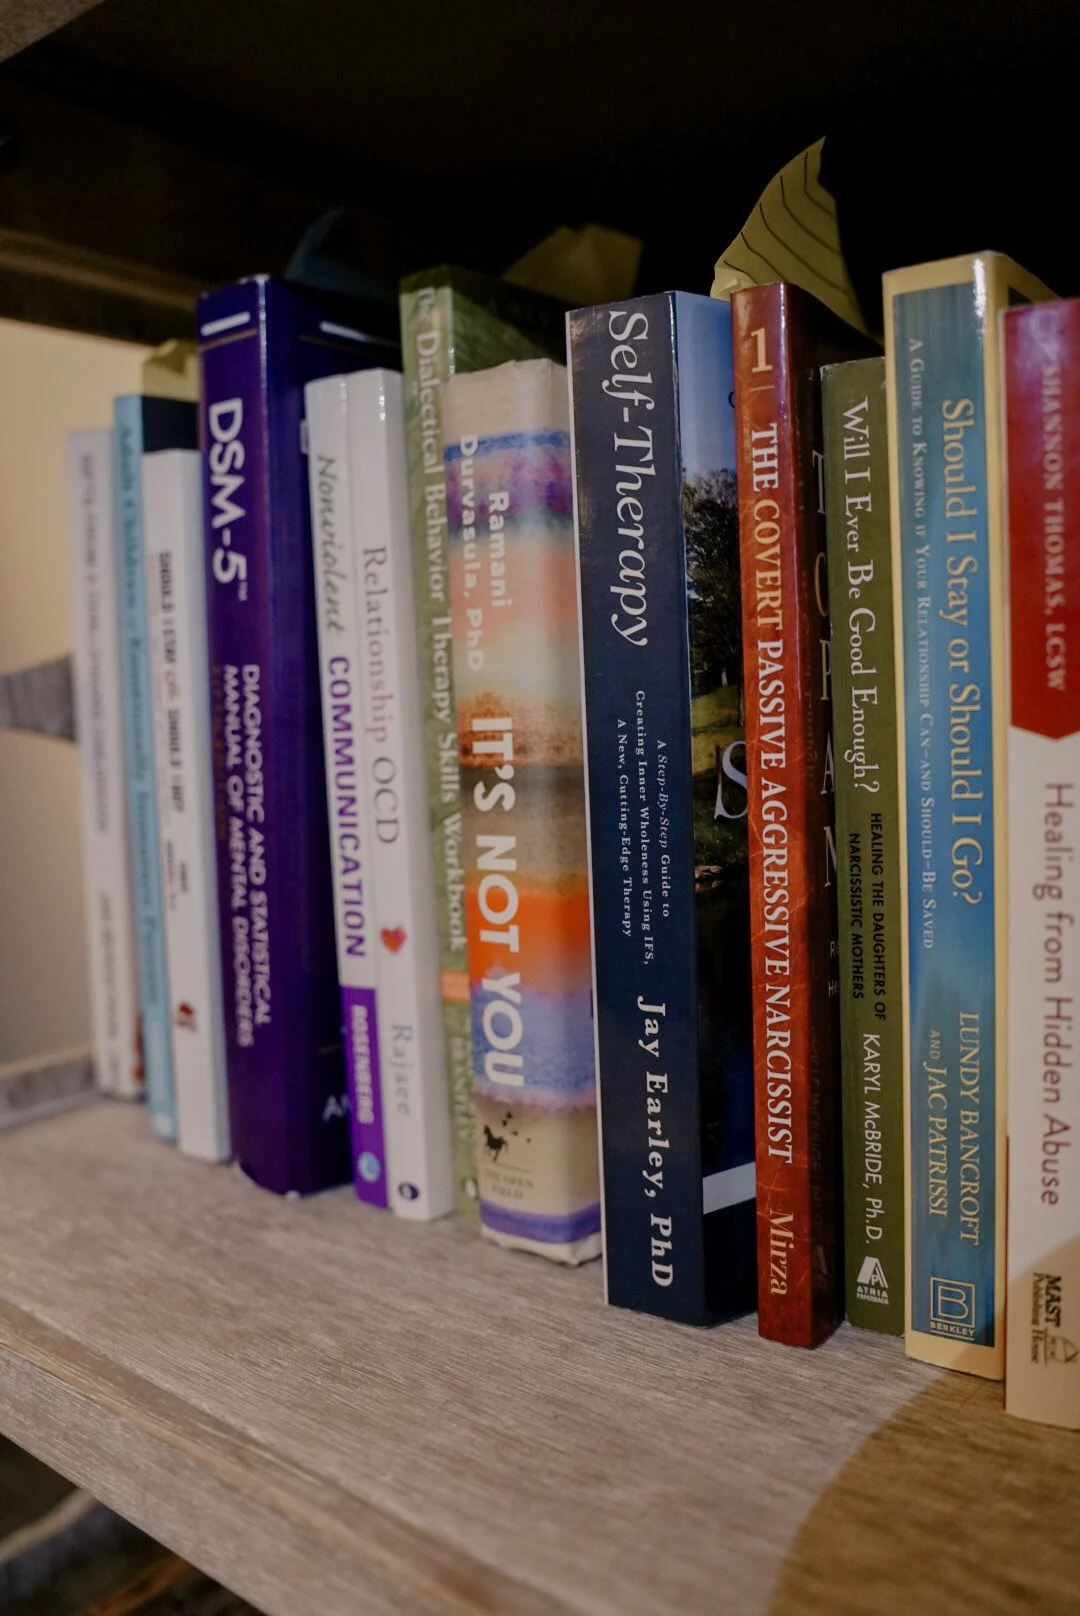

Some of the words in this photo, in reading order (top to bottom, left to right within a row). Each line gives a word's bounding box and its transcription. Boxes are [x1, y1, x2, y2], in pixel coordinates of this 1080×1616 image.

[750, 327, 773, 373] 1
[909, 338, 924, 353] A
[416, 330, 443, 474] Dialectical
[841, 397, 871, 461] Will
[1042, 363, 1064, 491] SHANNON
[209, 398, 247, 584] DSM-5
[601, 310, 655, 646] Self-Therapy
[750, 422, 780, 492] THE
[844, 468, 871, 485] I
[941, 398, 978, 519] Should
[316, 454, 349, 637] Nonviolent
[424, 482, 449, 603] Behavior
[460, 435, 482, 598] Durvasula,
[488, 491, 512, 608] Ramani
[844, 494, 872, 553] Ever
[946, 530, 977, 543] I
[1043, 498, 1065, 615] THOMAS,
[753, 499, 784, 630] COVERT
[847, 559, 874, 599] Be
[938, 555, 979, 627] Stay
[362, 545, 394, 745] Relationship
[431, 609, 454, 724] Therapy
[466, 608, 484, 672] PhD
[849, 607, 876, 676] Good
[948, 638, 971, 674] or
[1045, 622, 1066, 692] LCSW
[223, 664, 242, 770] MANUAL
[242, 664, 265, 822] DIAGNOSTIC
[617, 718, 627, 729] A
[635, 690, 647, 756] Creating
[657, 739, 667, 750] A
[757, 639, 787, 769] PASSIVE
[844, 686, 880, 793] Enough?
[949, 683, 984, 800] Should
[437, 731, 461, 803] Skills
[471, 717, 516, 812] IT'S
[616, 734, 628, 769] New,
[638, 761, 649, 802] Inner
[226, 775, 244, 812] OF
[329, 656, 366, 957] COMMUNICATION
[372, 757, 400, 845] OCD
[618, 774, 632, 872] Cutting-Edge
[657, 755, 670, 848] Step-By-Step
[952, 812, 982, 825] I
[229, 817, 248, 910] MENTAL
[248, 828, 267, 885] AND
[442, 812, 468, 952] Workbook
[639, 806, 651, 884] Wholeness
[660, 854, 671, 898] Guide
[760, 777, 790, 976] AGGRESSIVE
[849, 833, 863, 928] NARCISSISTIC
[870, 813, 884, 876] HEALING
[951, 836, 984, 906] Go?
[1032, 782, 1073, 901] Healing
[475, 835, 520, 952] NOT
[621, 877, 634, 937] Therapy
[640, 889, 653, 931] Using
[662, 902, 671, 917] to
[872, 881, 885, 907] THE
[231, 915, 254, 1047] DISORDERS
[250, 891, 272, 1026] STATISTICAL
[643, 936, 655, 965] IFS,
[851, 933, 864, 999] MOTHERS
[872, 912, 886, 996] DAUGHTERS
[1043, 911, 1072, 984] from
[481, 972, 524, 1088] YOU
[637, 995, 666, 1058] Jay
[874, 1001, 887, 1021] OF
[1042, 996, 1073, 1104] Hidden
[765, 983, 793, 1164] NARCISSIST
[863, 1033, 881, 1095] KARYL
[923, 1062, 948, 1108] JAC
[959, 1011, 980, 1103] LUNDY
[642, 1070, 670, 1198] Earley,
[862, 1101, 882, 1189] McBRIDE,
[928, 1115, 948, 1217] PATRISSI
[1040, 1112, 1071, 1207] Abuse
[958, 1109, 980, 1246] BANCROFT
[650, 1212, 674, 1287] PhD
[768, 1208, 795, 1297] Mirza
[865, 1197, 885, 1245] Ph.D.
[857, 1286, 888, 1298] ATRIA
[930, 1321, 975, 1337] BERKLEY
[1045, 1274, 1062, 1328] MAST
